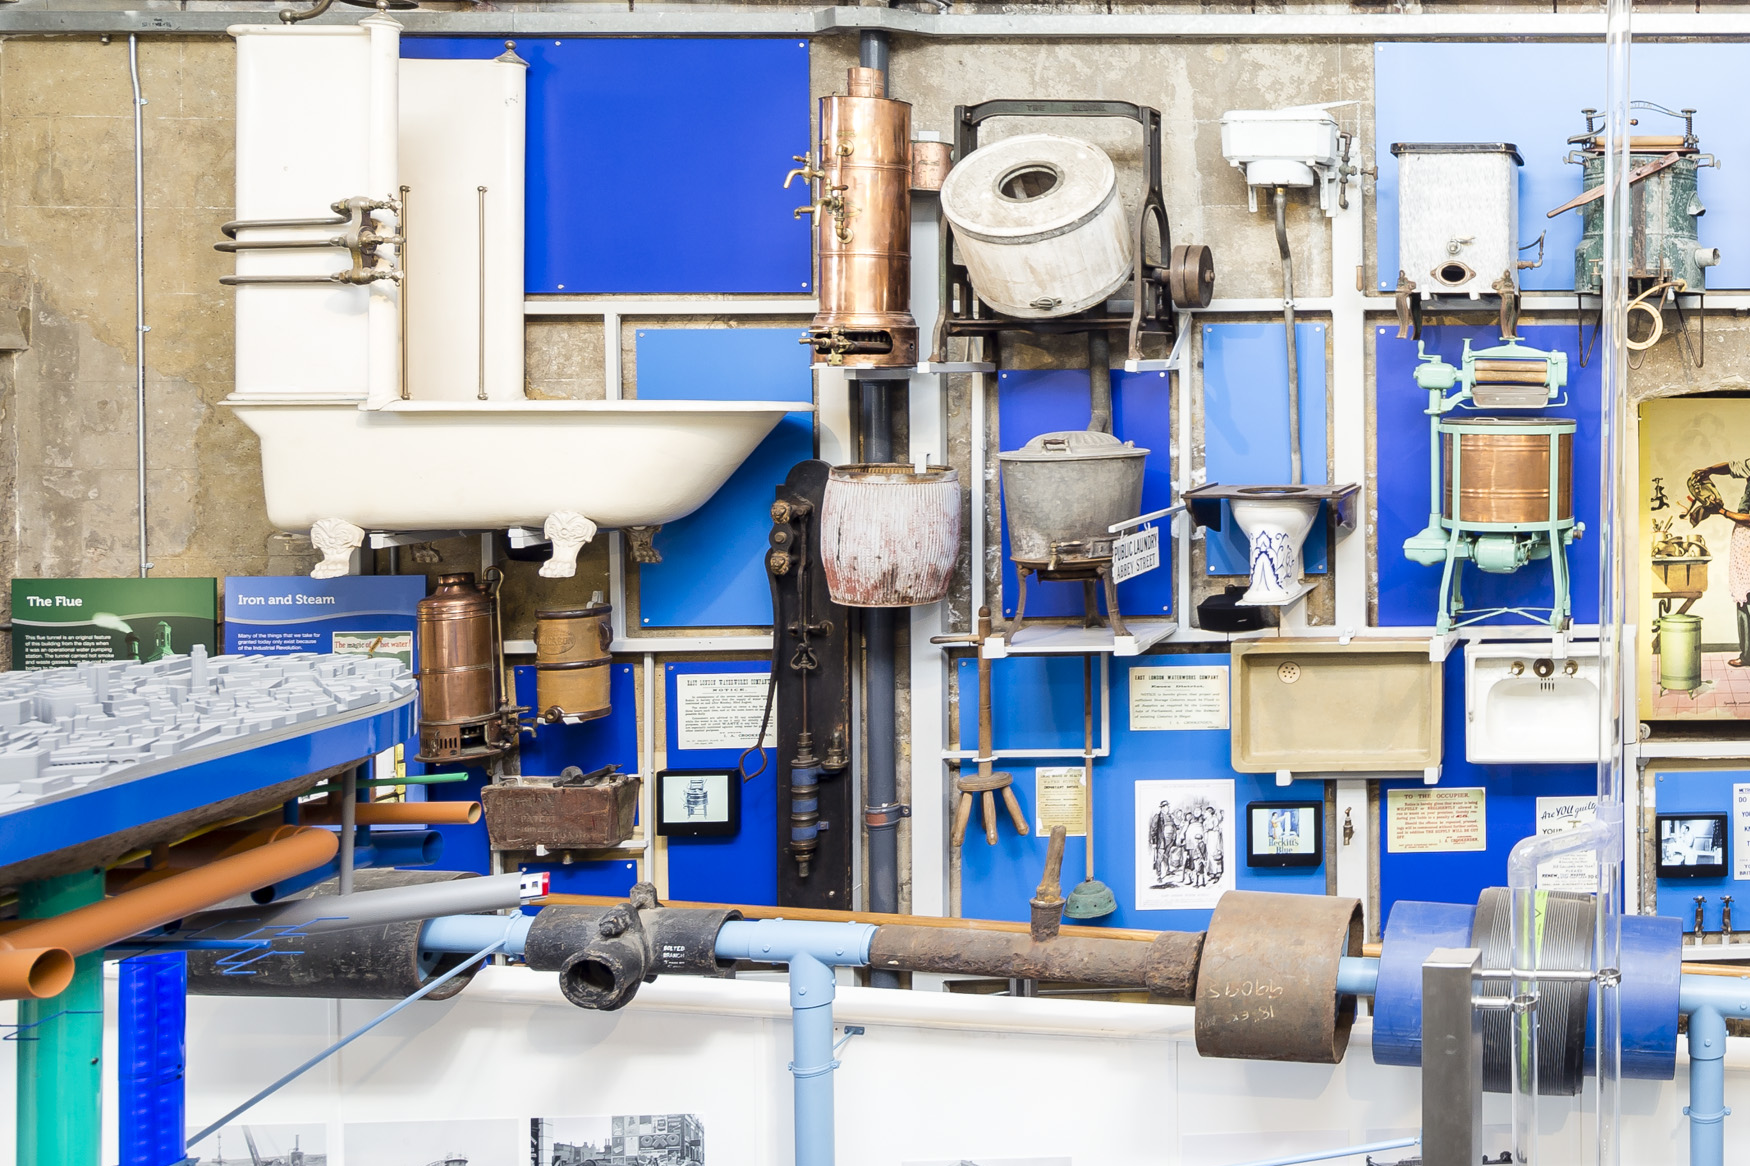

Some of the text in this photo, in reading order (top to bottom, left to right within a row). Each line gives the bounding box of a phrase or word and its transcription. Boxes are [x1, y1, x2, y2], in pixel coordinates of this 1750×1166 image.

[1114, 533, 1158, 563] PUBLIC LAUNDRY
[1116, 553, 1156, 580] ABBEY STREET
[26, 596, 83, 607] The Flue
[238, 594, 335, 605] Iron and Steam
[334, 641, 346, 649] The
[346, 642, 365, 650] magic
[1541, 801, 1597, 820] Are YOU guilty
[640, 1133, 680, 1148] OXO
